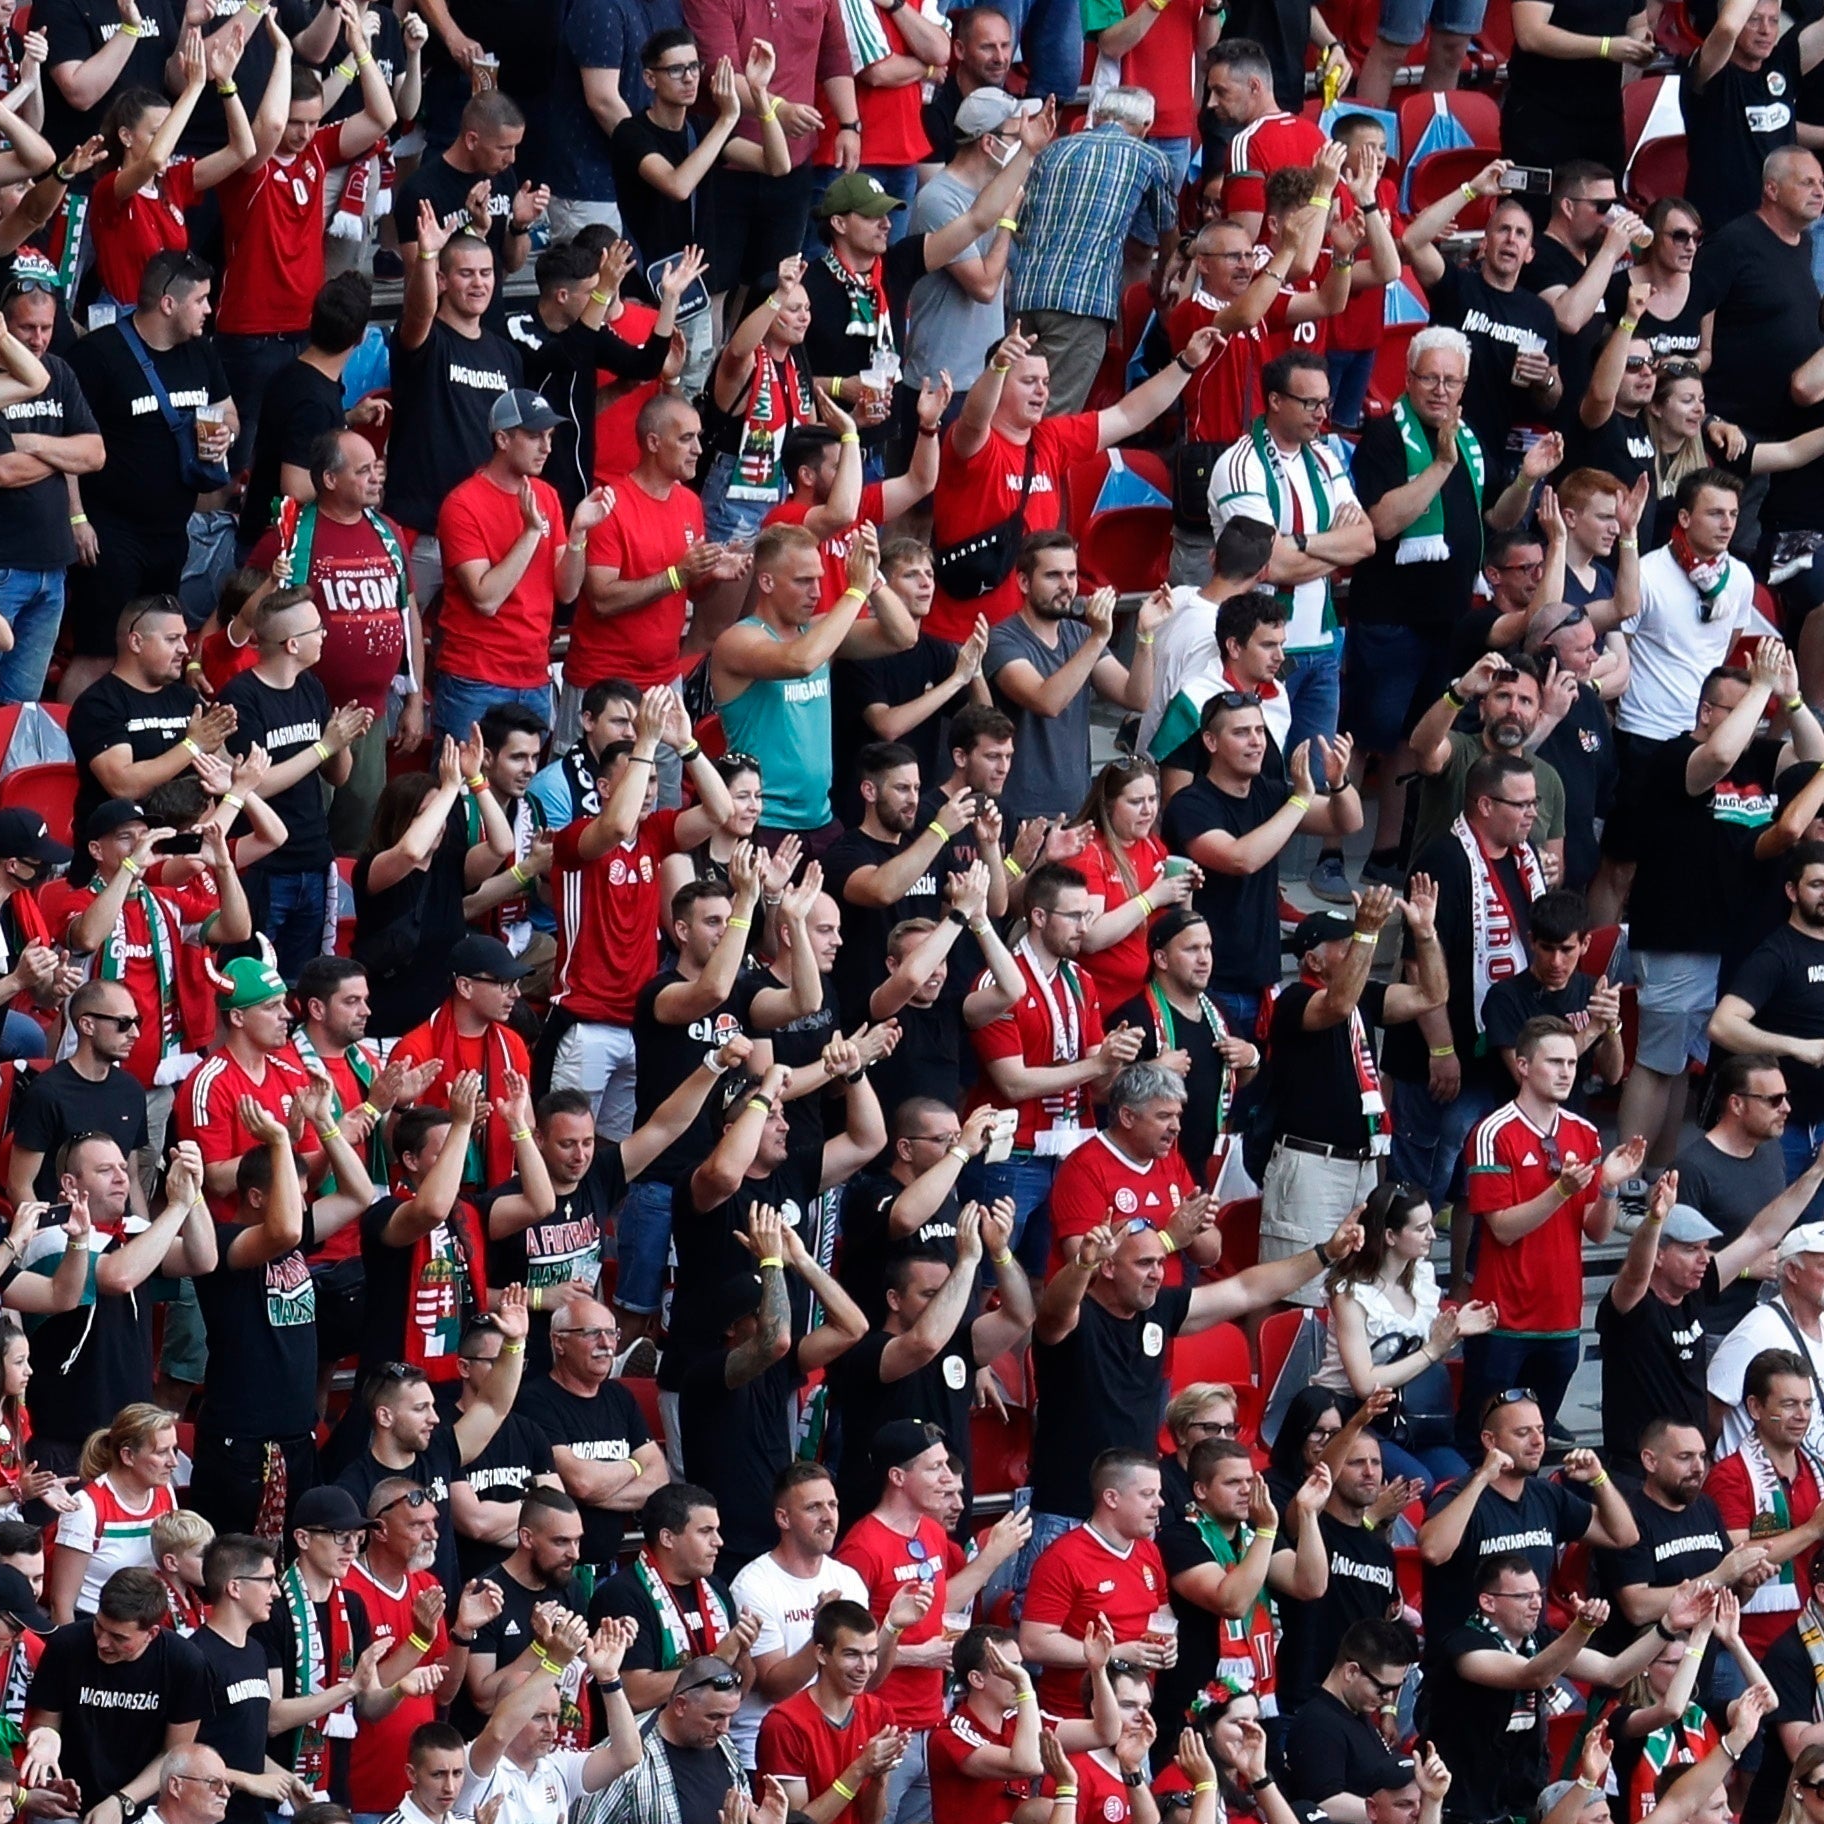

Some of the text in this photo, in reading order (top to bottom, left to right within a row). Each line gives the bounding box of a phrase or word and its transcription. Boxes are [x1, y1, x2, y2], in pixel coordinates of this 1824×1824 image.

[321, 576, 401, 612] ICON
[1655, 1531, 1724, 1562] MAGYARORSZÁ
[79, 1685, 160, 1711] MAGYARORSZÁG
